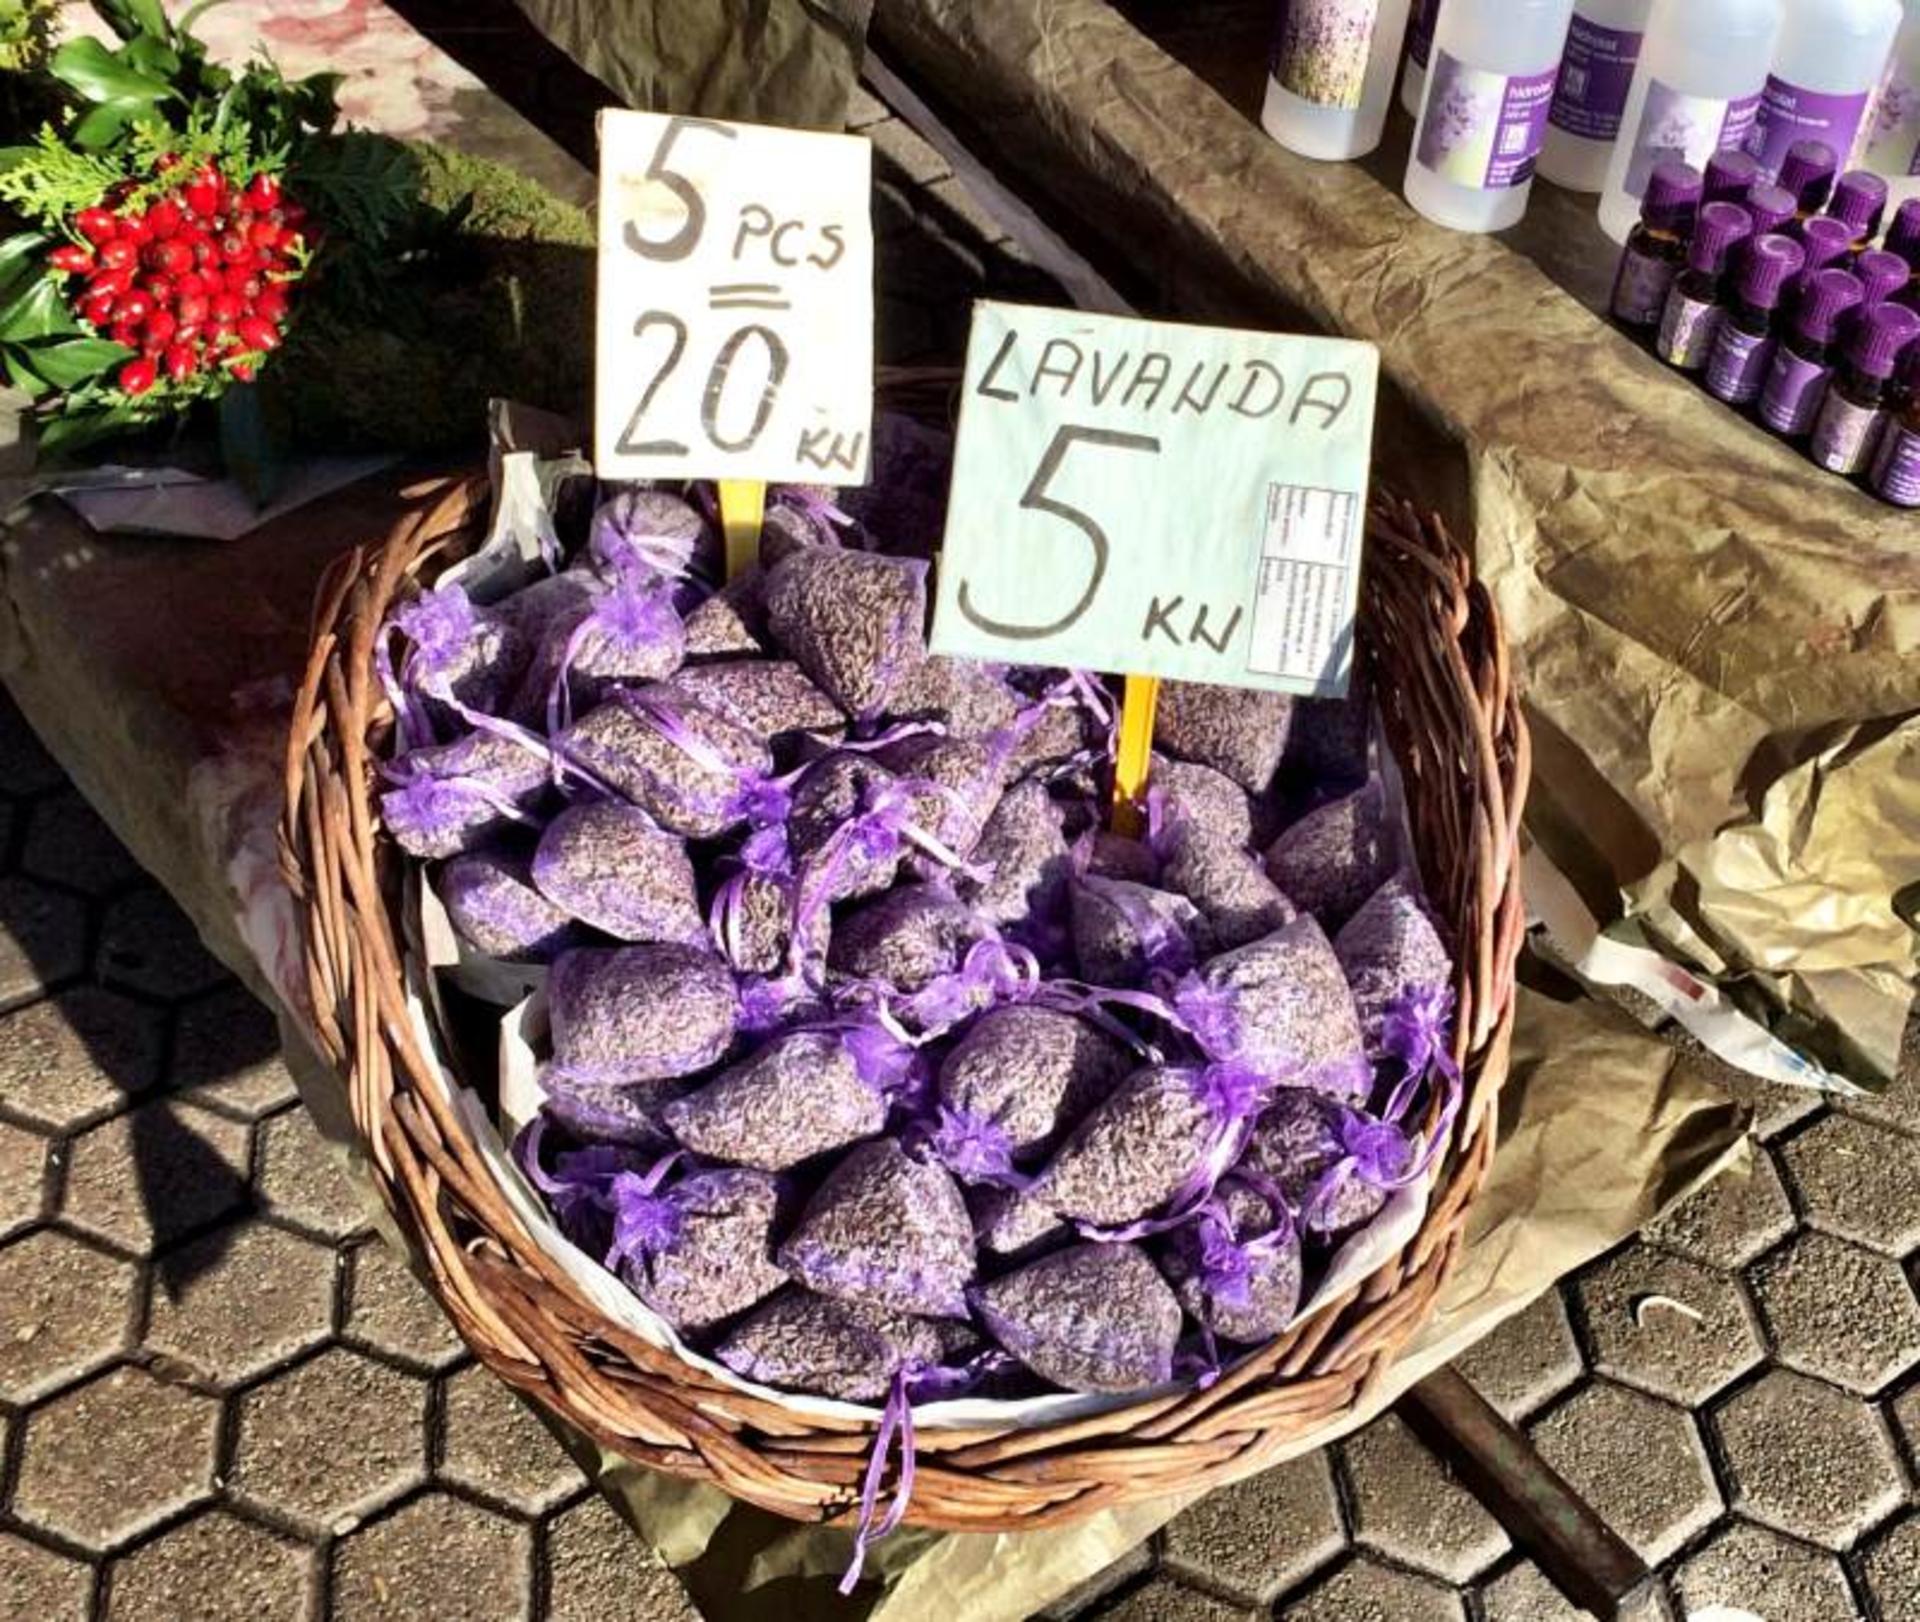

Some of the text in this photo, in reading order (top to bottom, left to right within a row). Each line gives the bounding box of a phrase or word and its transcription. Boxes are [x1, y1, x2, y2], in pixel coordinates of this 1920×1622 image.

[623, 116, 846, 271] 5 PCS
[614, 310, 864, 472] 20 KN
[975, 329, 1353, 431] LAVANDA
[957, 424, 1162, 642] 5
[1141, 595, 1243, 654] KN
